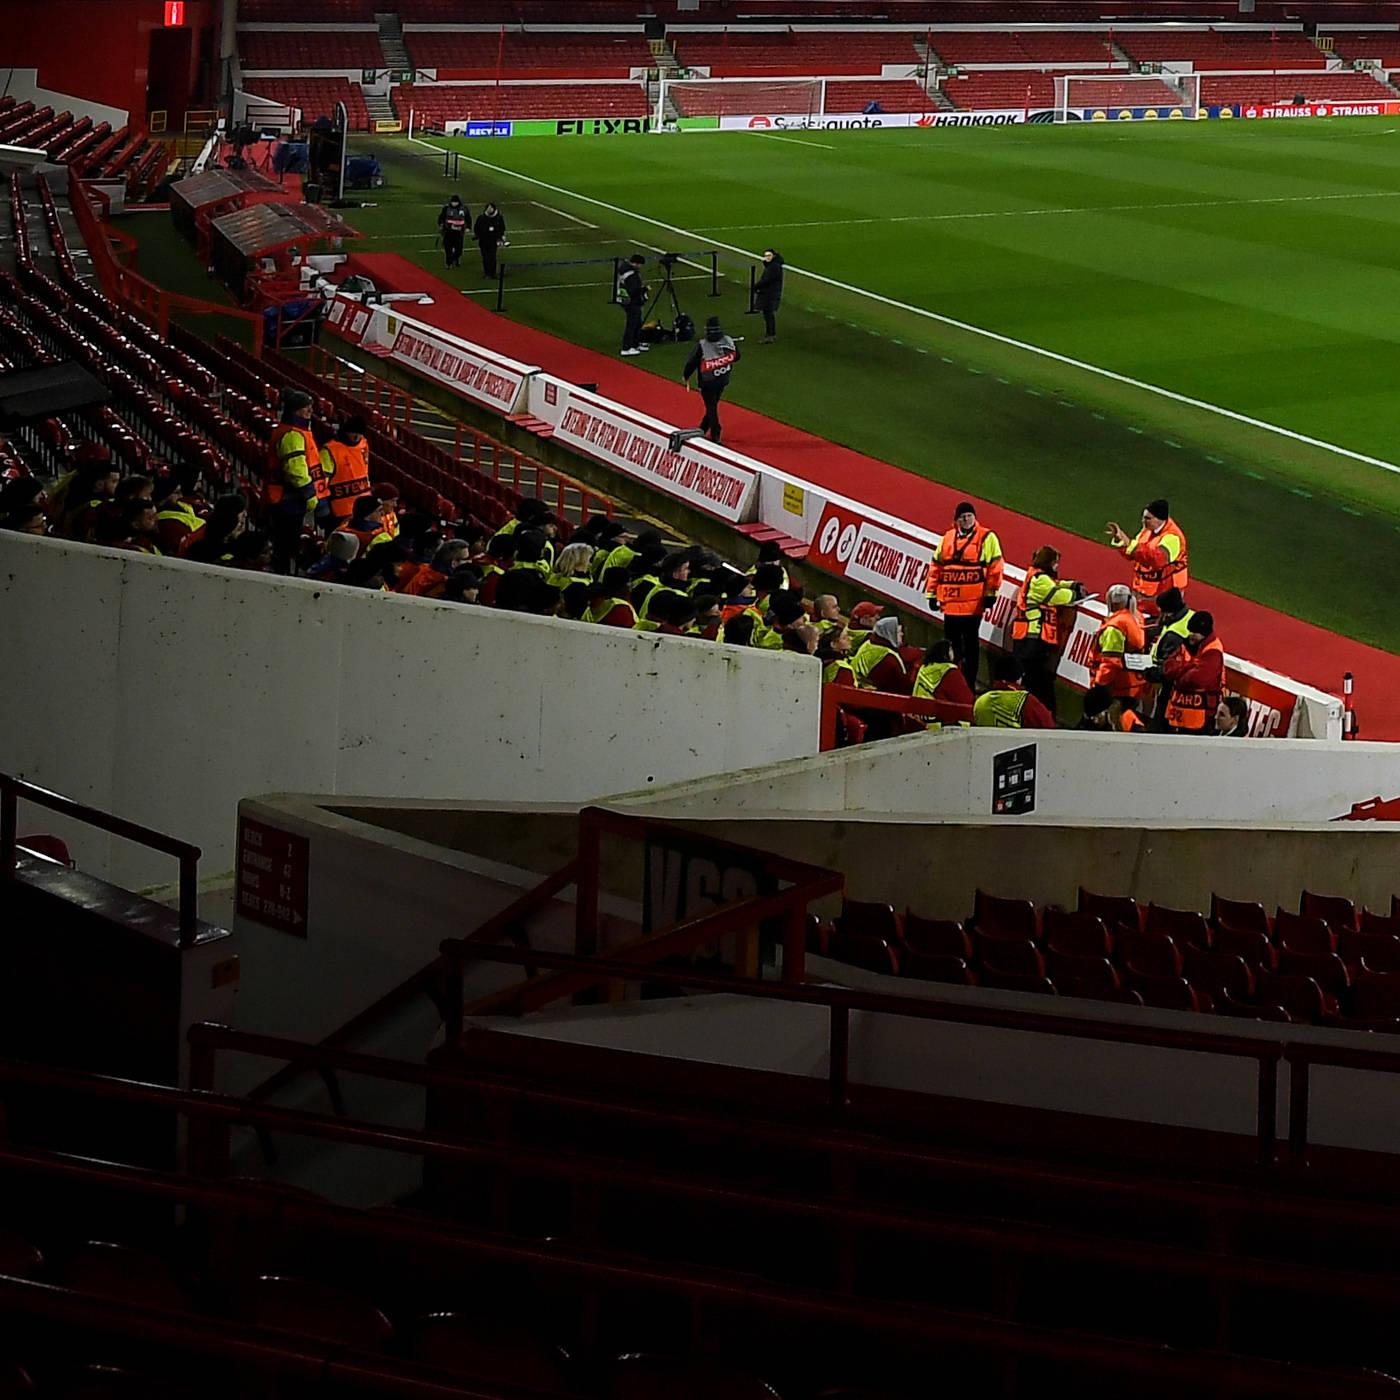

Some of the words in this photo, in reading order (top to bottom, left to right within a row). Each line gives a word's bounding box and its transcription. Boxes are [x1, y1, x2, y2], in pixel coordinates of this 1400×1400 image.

[1262, 105, 1311, 118] STRAUSS
[1331, 105, 1380, 116] STRAUSS
[855, 537, 903, 581] ENTERING
[899, 553, 923, 588] THE
